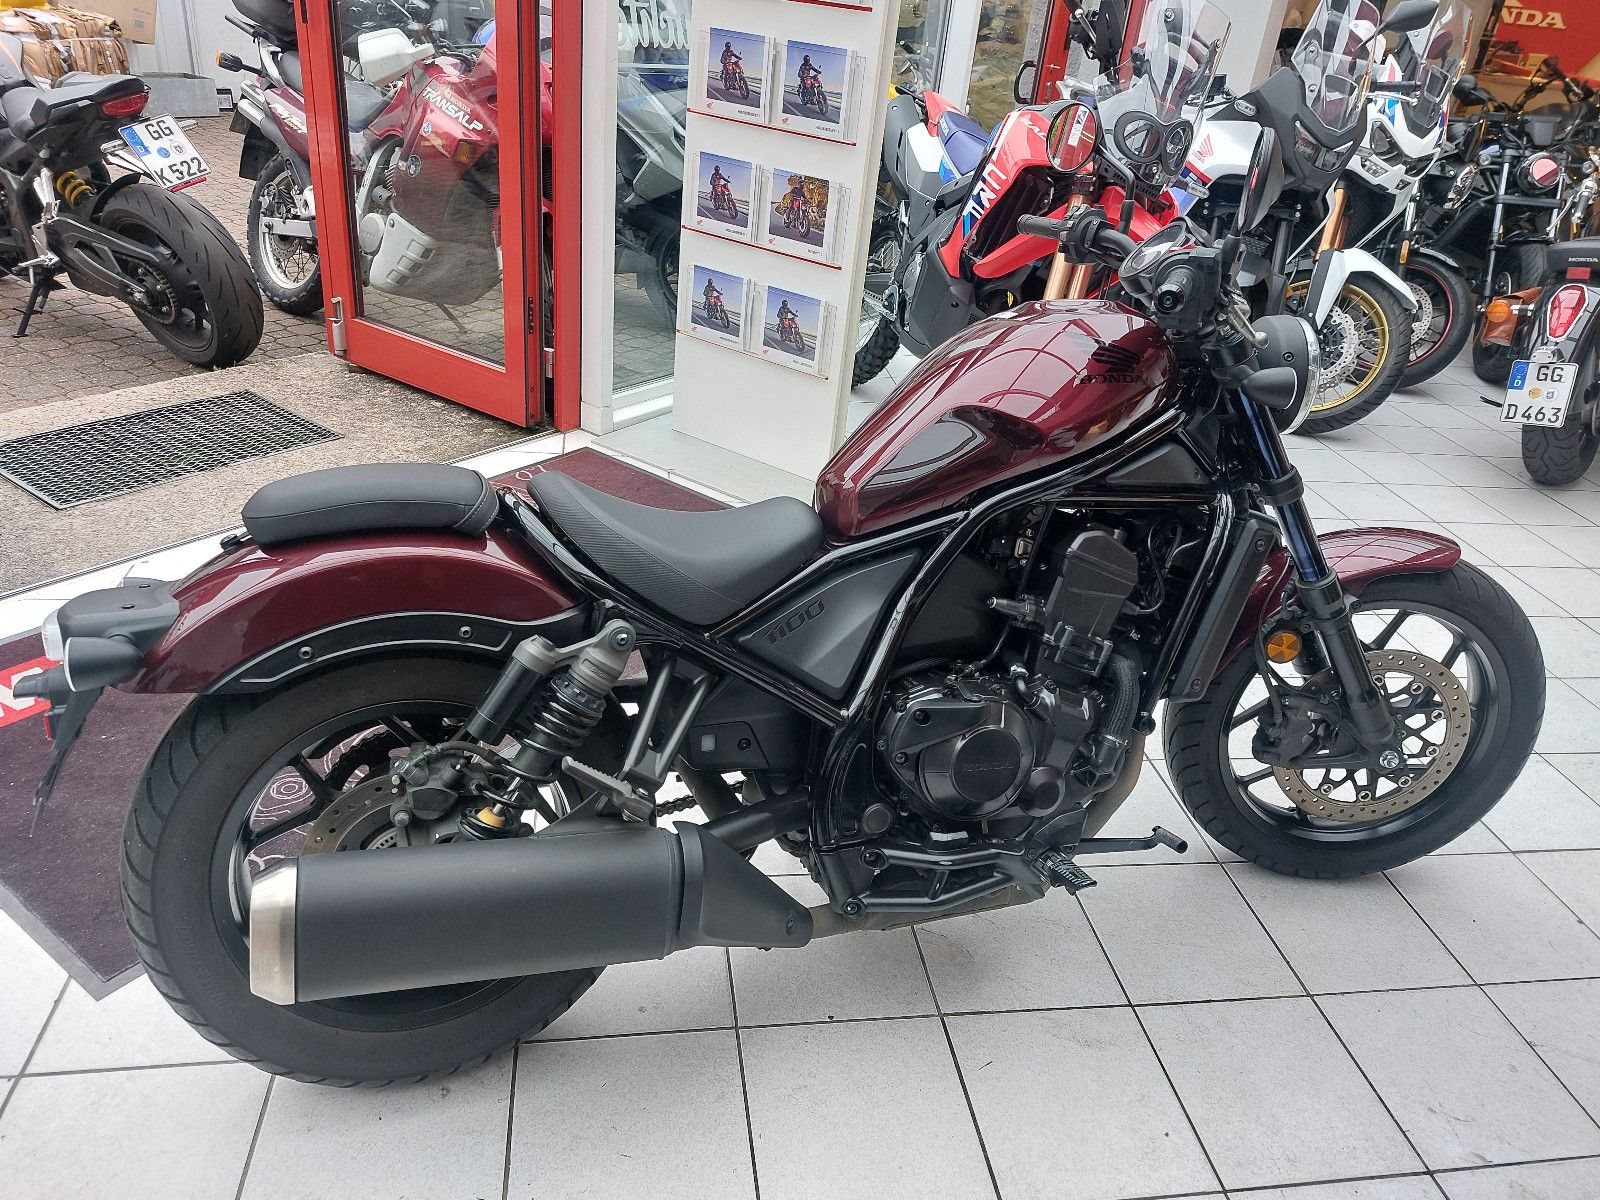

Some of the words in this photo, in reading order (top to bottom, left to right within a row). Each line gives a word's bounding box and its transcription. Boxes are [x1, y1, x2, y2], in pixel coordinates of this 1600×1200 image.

[422, 86, 484, 131] TRANSALP
[144, 119, 175, 141] GG
[154, 167, 174, 186] K
[167, 156, 208, 181] 522
[1079, 374, 1143, 385] HONDA
[1536, 365, 1565, 383] GG
[1504, 403, 1519, 420] D
[1520, 405, 1562, 424] 463
[763, 599, 825, 647] 1100
